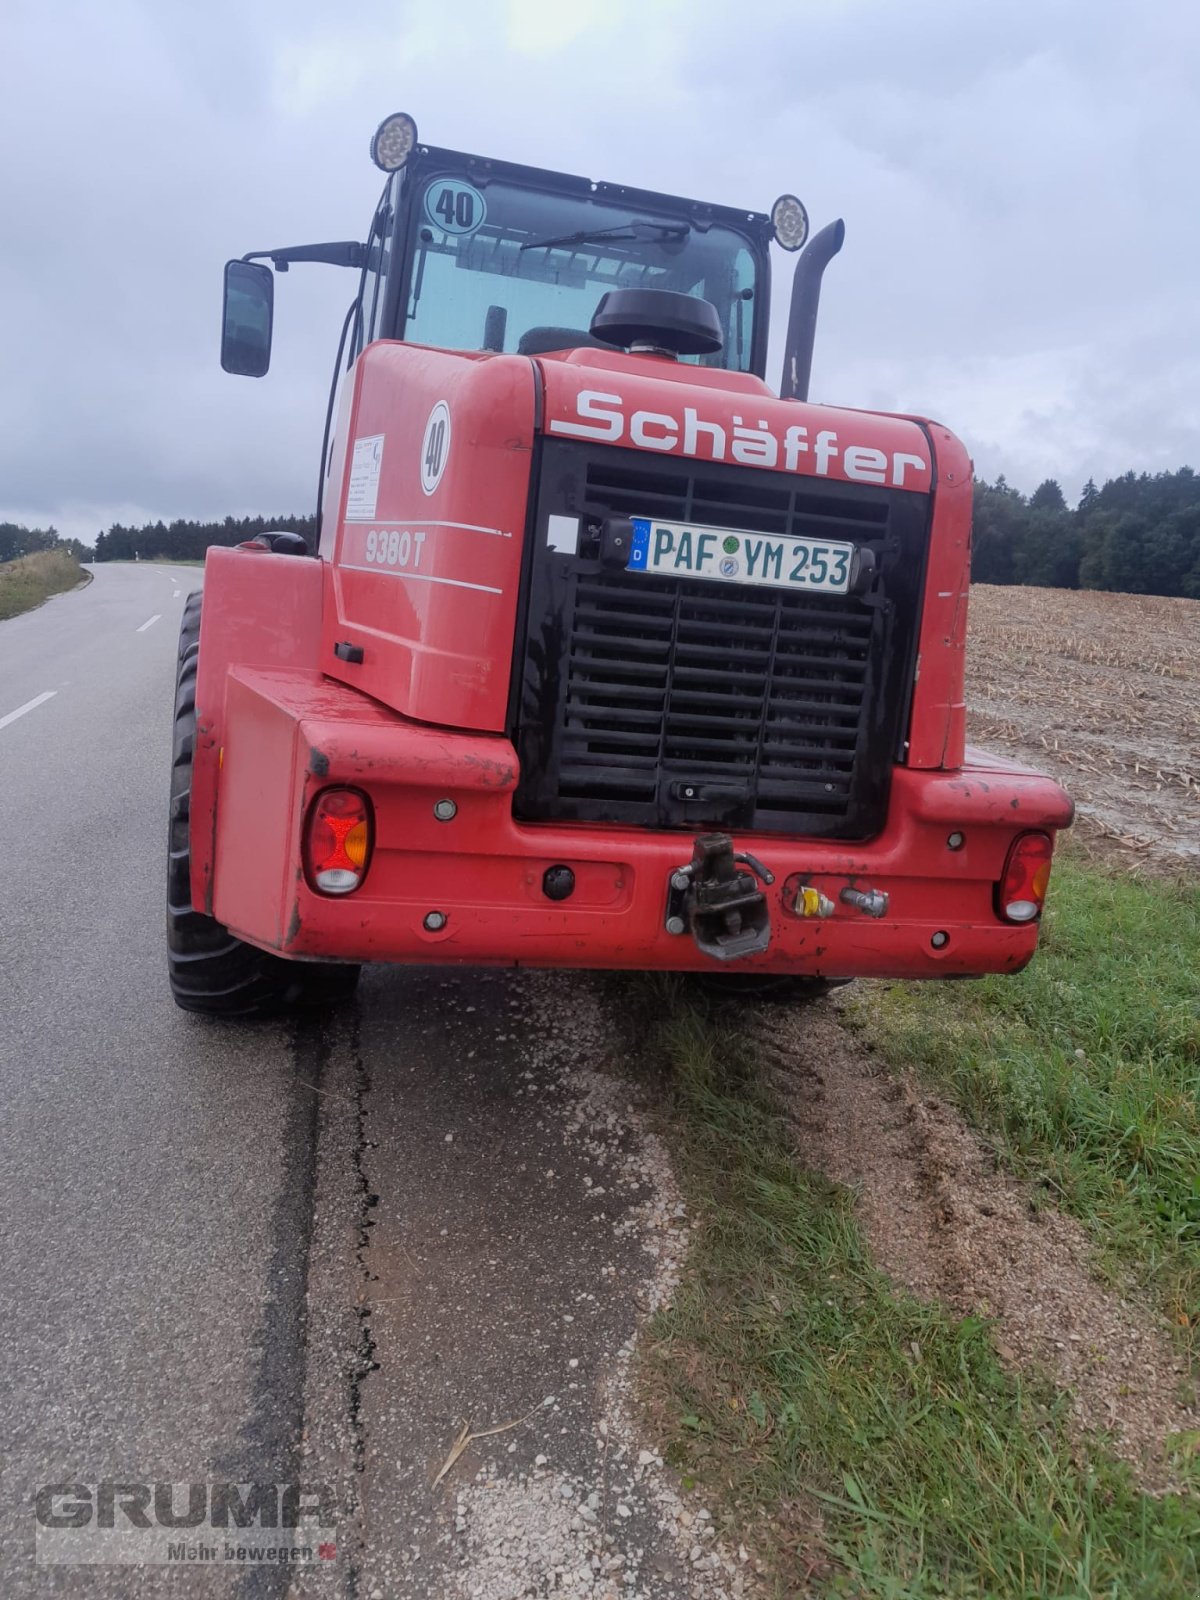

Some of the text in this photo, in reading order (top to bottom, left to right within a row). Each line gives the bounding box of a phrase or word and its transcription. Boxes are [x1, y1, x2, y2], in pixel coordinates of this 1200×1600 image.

[435, 189, 474, 228] 40
[425, 420, 445, 477] 40
[550, 389, 927, 487] Schäffer
[633, 550, 642, 561] D
[653, 528, 850, 586] PAF YM 253
